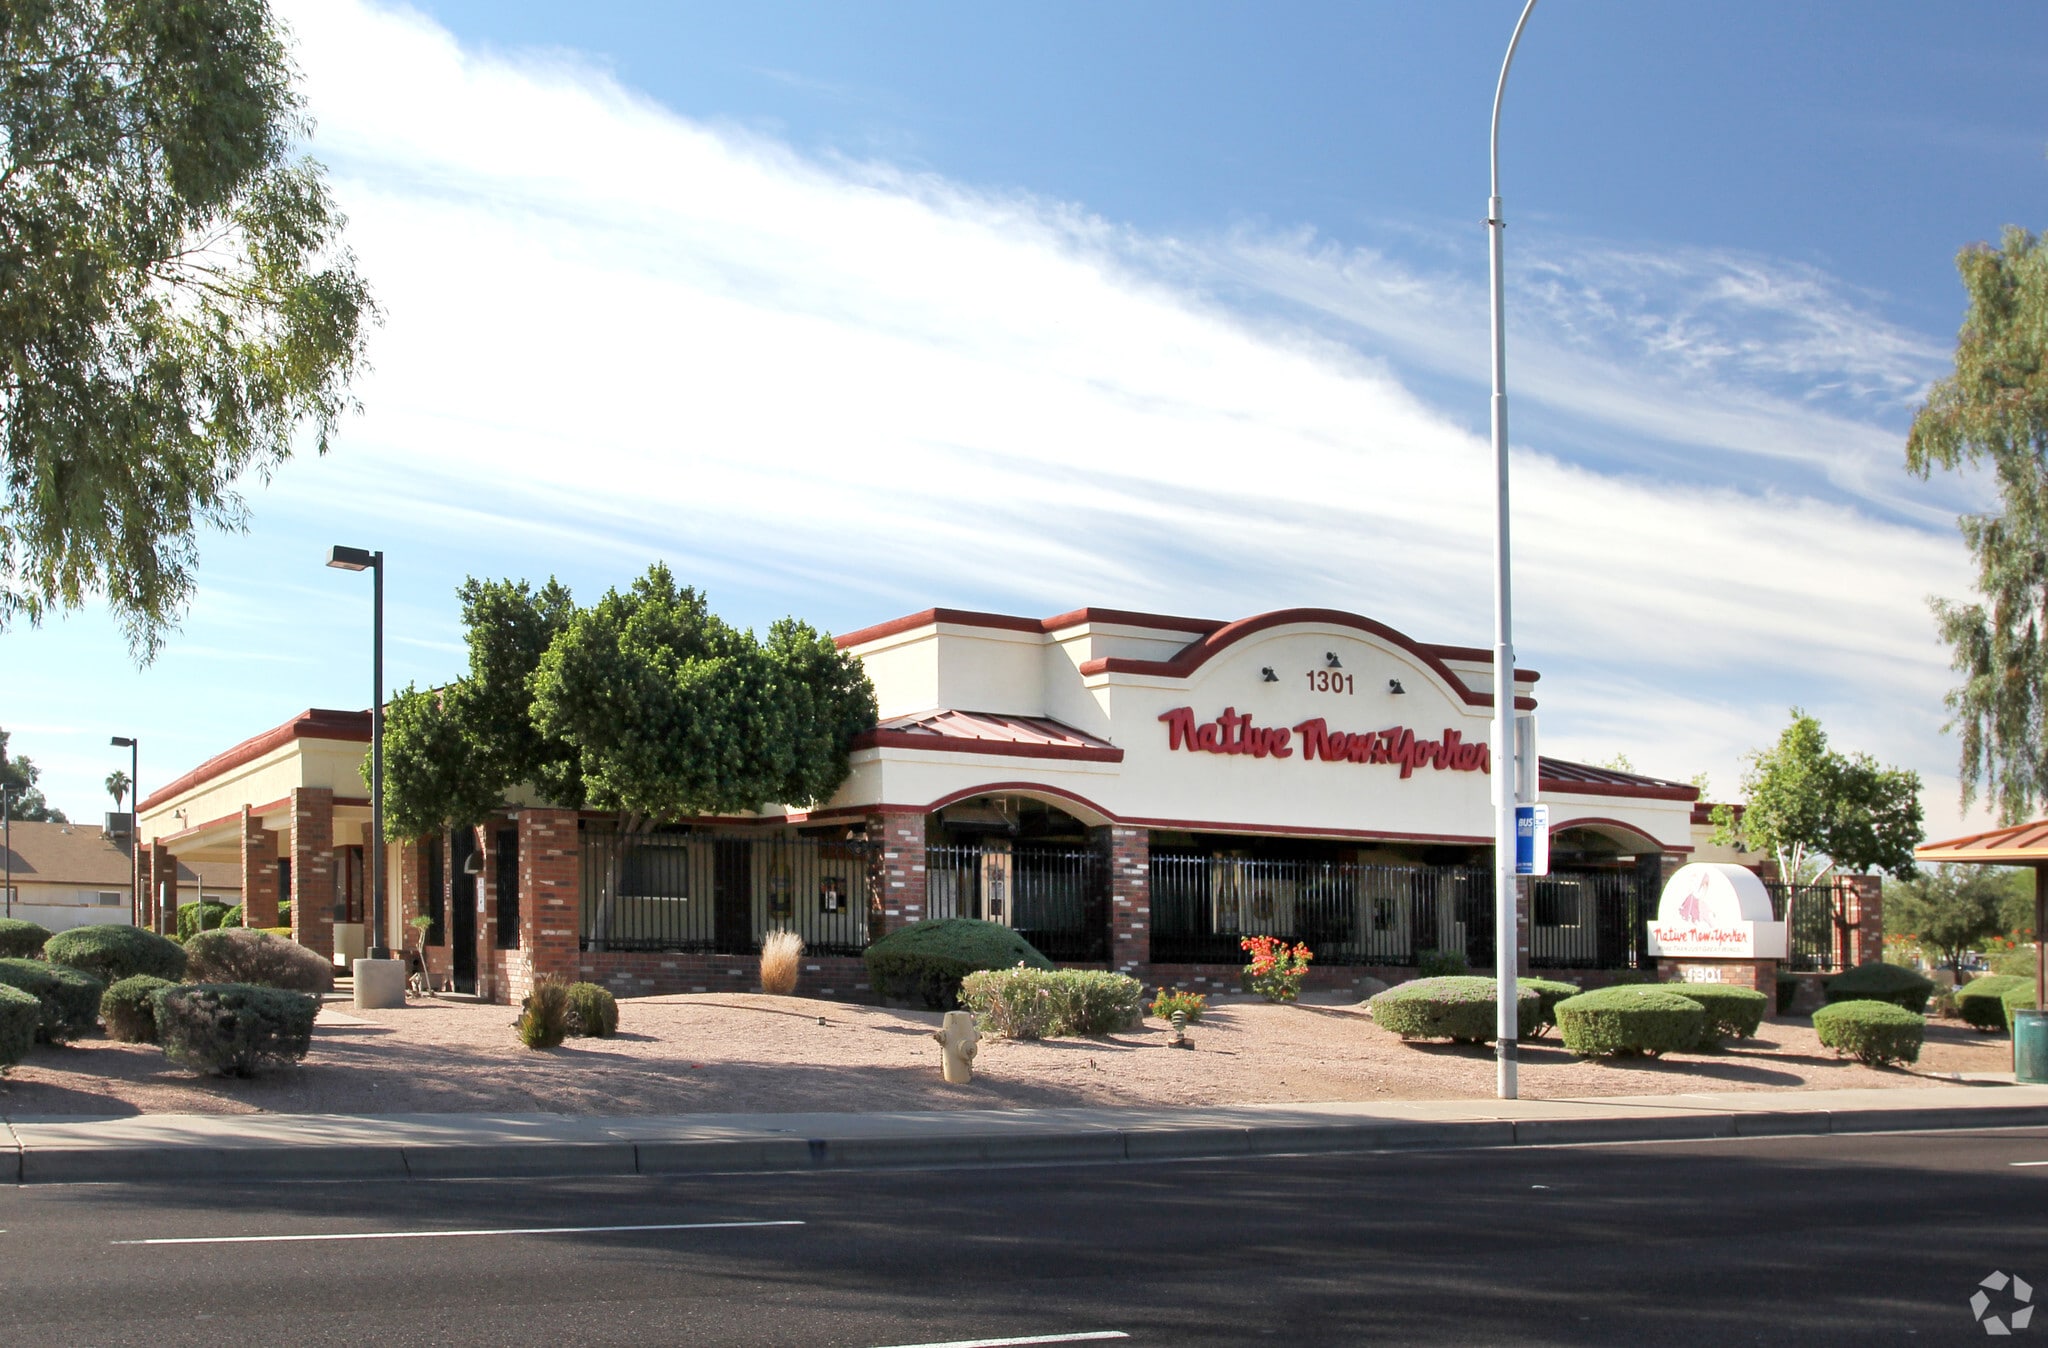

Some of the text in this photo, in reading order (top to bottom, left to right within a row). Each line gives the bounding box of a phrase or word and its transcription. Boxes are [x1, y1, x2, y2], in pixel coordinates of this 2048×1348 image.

[1306, 670, 1354, 695] 1301
[1158, 705, 1294, 758] Native
[1518, 817, 1533, 827] BUS
[1653, 927, 1687, 942] Native
[1688, 967, 1721, 982] 1301
